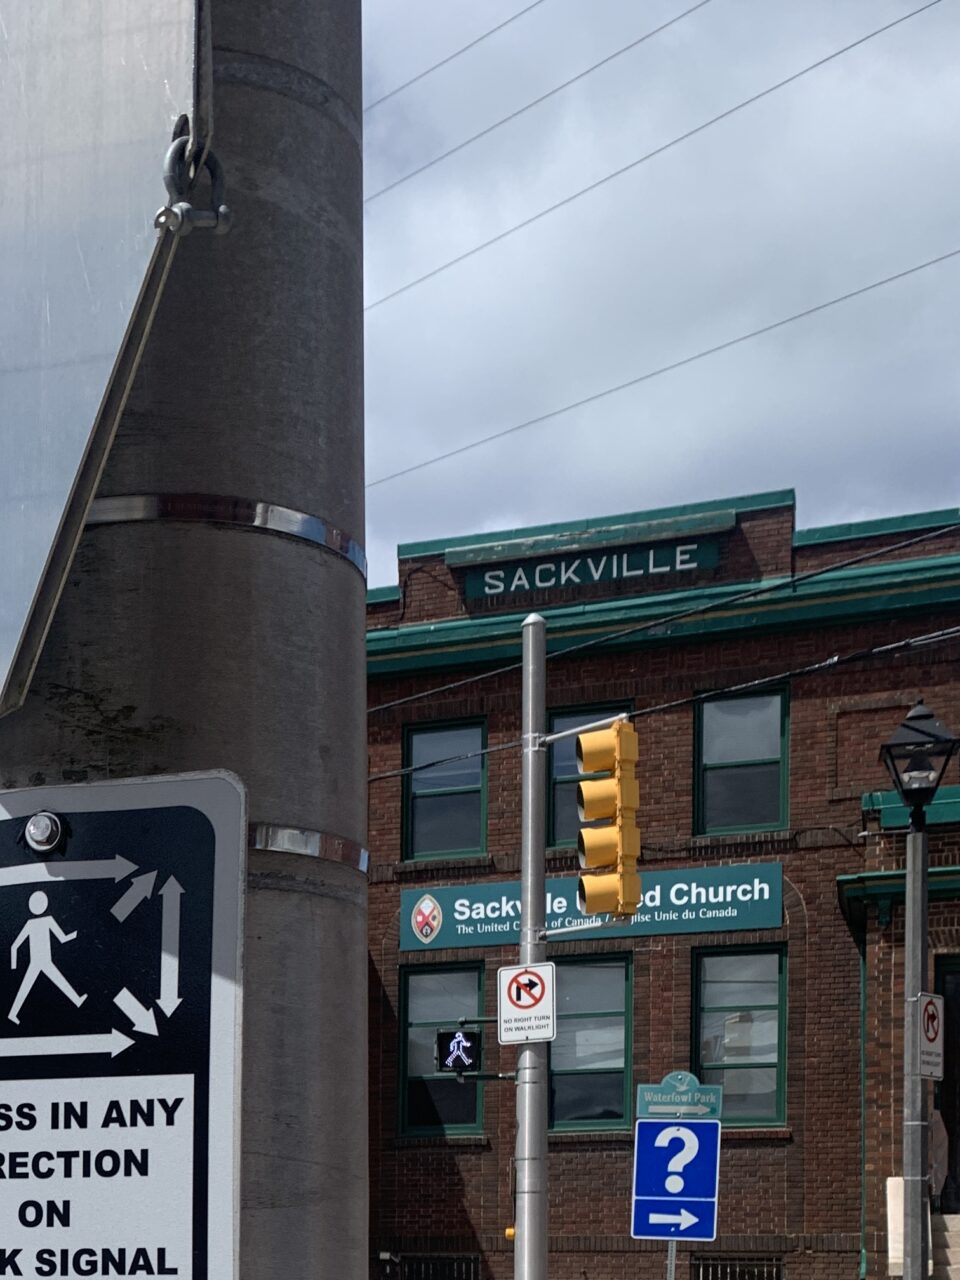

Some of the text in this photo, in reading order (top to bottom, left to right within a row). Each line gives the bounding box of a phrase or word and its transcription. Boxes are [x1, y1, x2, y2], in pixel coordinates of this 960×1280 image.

[484, 544, 698, 595] SACKVILLE
[669, 878, 770, 906] Church
[456, 924, 474, 935] The
[477, 920, 510, 934] United
[551, 917, 564, 929] of
[655, 910, 679, 922] Unie
[682, 909, 696, 920] du
[699, 906, 738, 919] Canada
[644, 1091, 717, 1104] Waterfowl Park
[50, 1101, 88, 1130] IN
[101, 1097, 185, 1129] ANY
[18, 1199, 71, 1228] ON
[34, 1247, 179, 1277] SIGNAL
